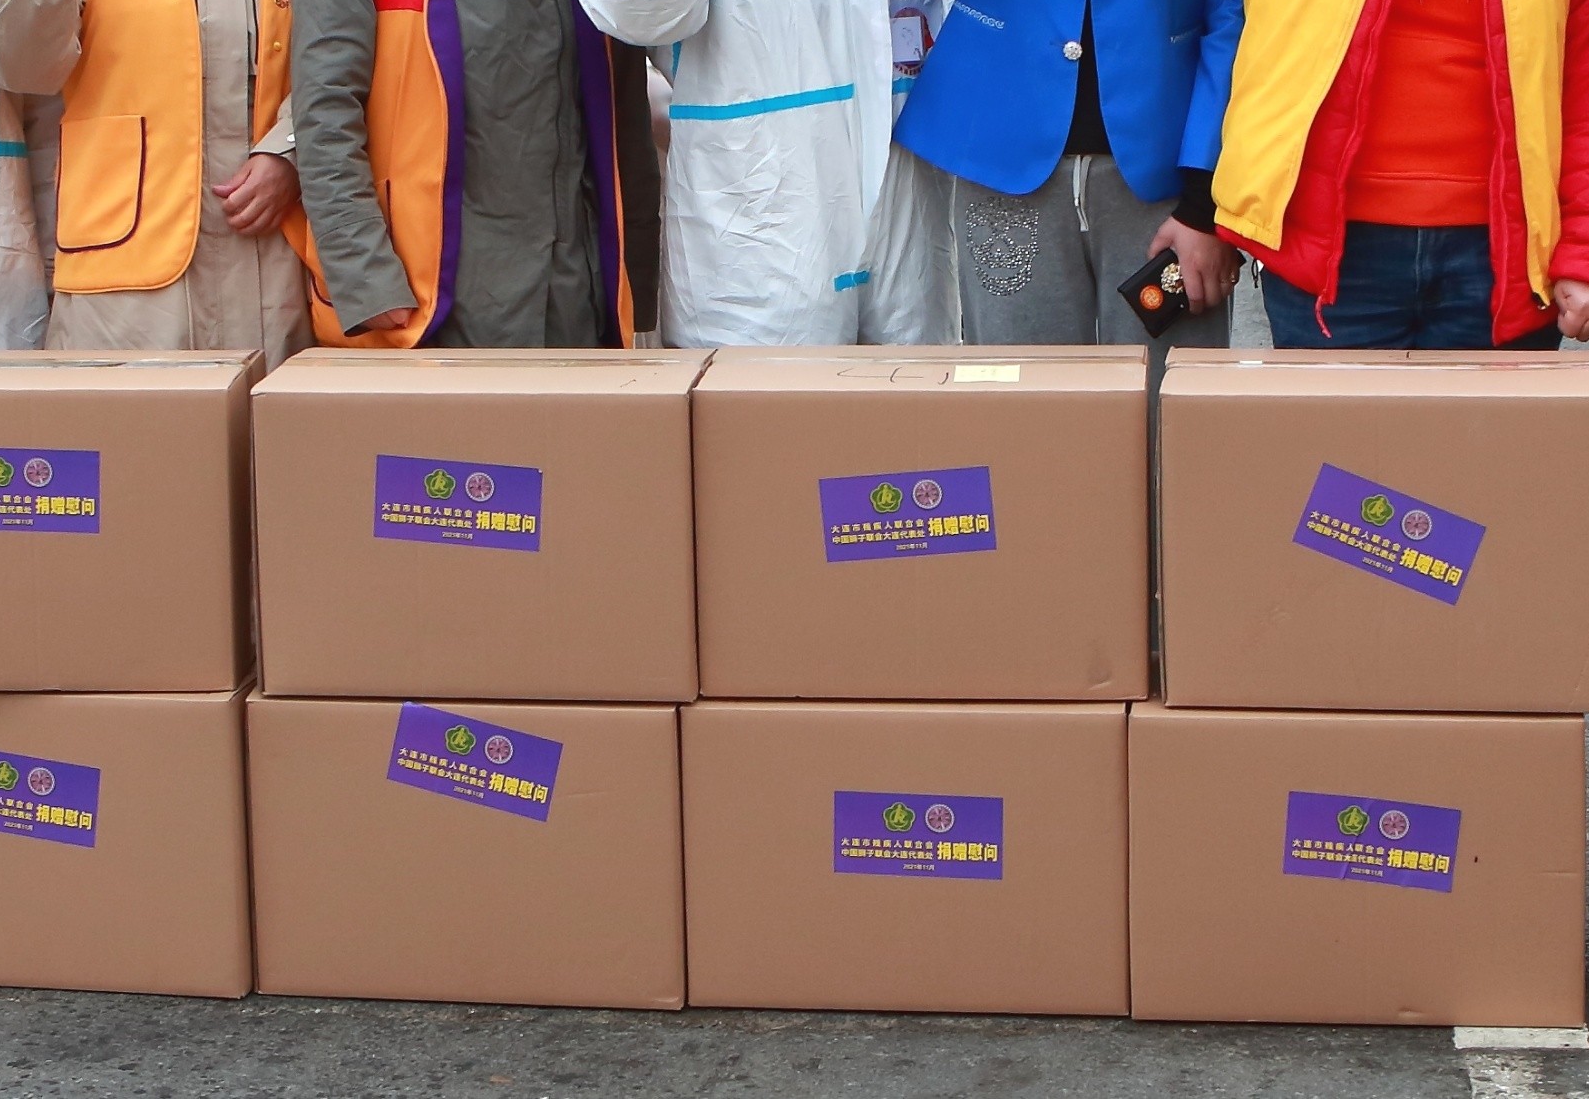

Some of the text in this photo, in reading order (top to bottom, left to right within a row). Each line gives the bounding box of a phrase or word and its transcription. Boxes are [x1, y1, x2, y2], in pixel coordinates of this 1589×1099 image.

[34, 495, 95, 516] 捐赠慰问
[475, 510, 536, 534] 捐赠慰问
[927, 514, 990, 537] 捐赠慰问
[1399, 546, 1464, 587] 捐赠慰问
[487, 771, 549, 804] 捐赠慰问
[35, 803, 93, 831] 捐赠慰问
[936, 841, 998, 862] 捐赠慰问
[1386, 847, 1451, 874] 捐赠慰问
